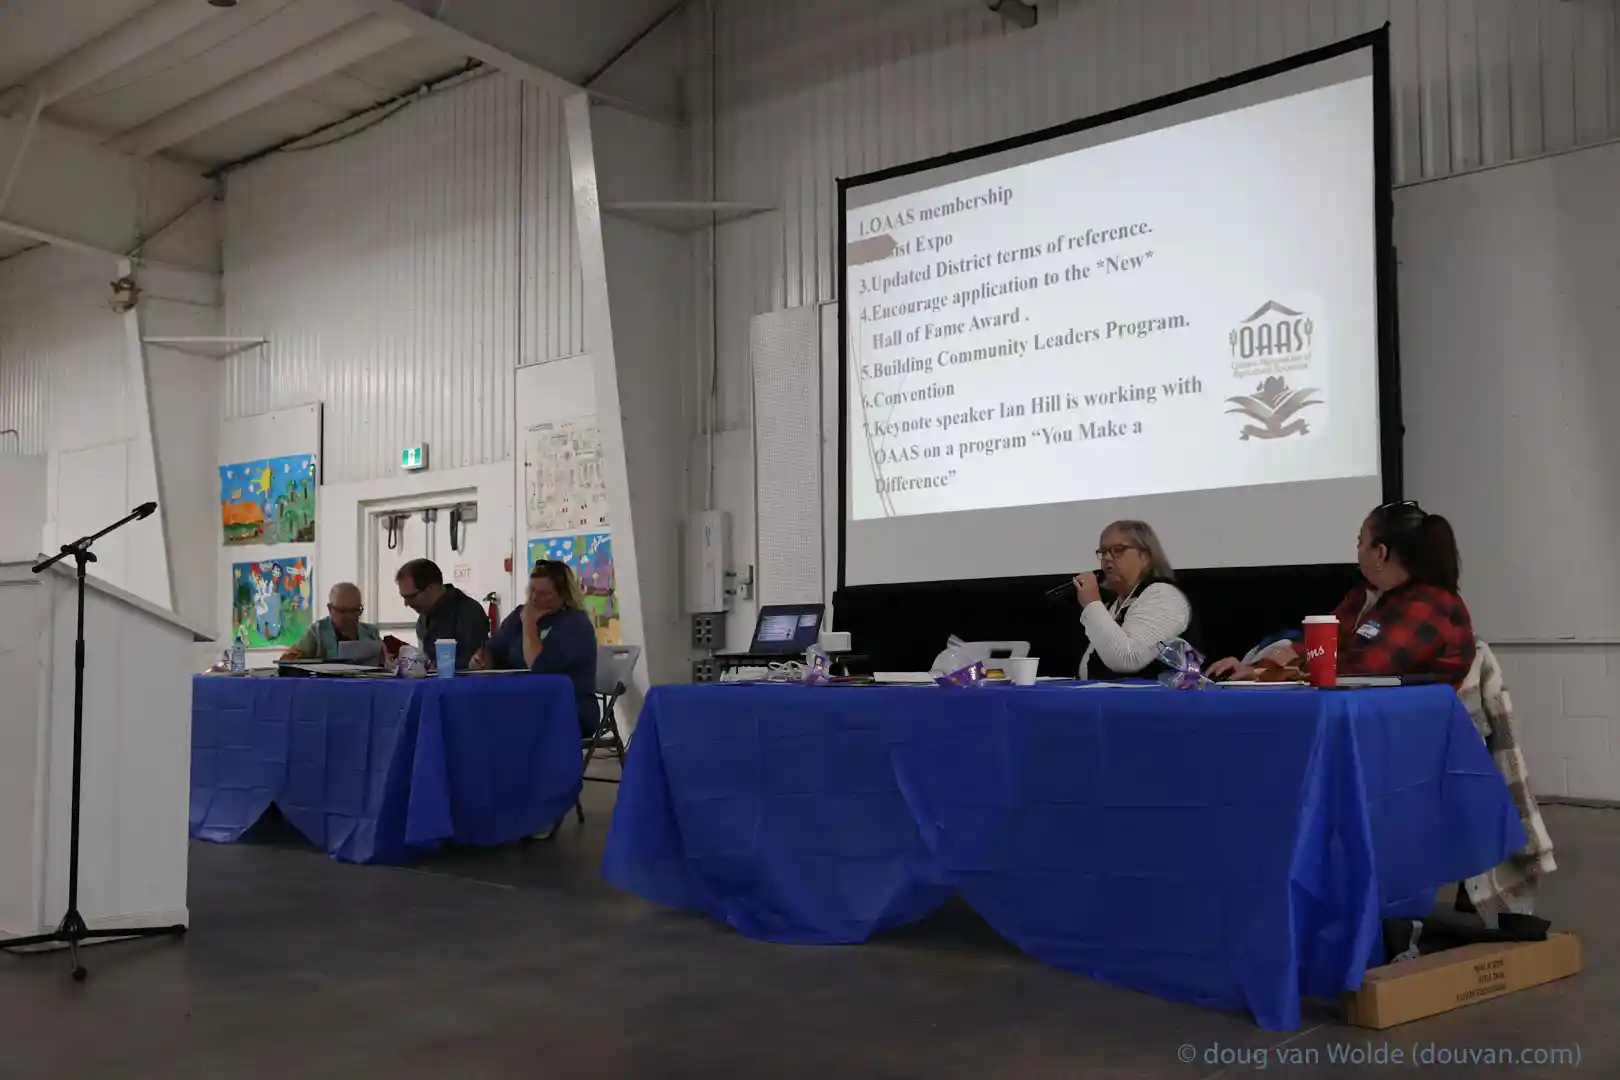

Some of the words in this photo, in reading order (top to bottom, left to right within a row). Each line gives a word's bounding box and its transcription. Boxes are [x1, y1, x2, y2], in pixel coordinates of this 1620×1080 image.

[860, 208, 916, 236] 1.OAAS
[919, 186, 1013, 221] membership
[860, 264, 931, 294] 3.Updated
[937, 252, 992, 278] District
[997, 244, 1042, 265] terms
[1047, 235, 1065, 253] of
[1068, 221, 1153, 249] reference.
[916, 233, 953, 253] Expo
[860, 295, 948, 323] 4.Encourage
[952, 275, 1038, 308] application
[1044, 272, 1059, 286] to
[1065, 264, 1090, 282] the
[861, 356, 933, 381] 5.Building
[937, 338, 1028, 367] Community
[1034, 328, 1100, 351] Leaders
[1106, 313, 1191, 339] Program.
[873, 330, 902, 350] Hall
[906, 326, 921, 343] of
[925, 322, 965, 341] Fame
[969, 306, 1020, 332] Award
[1239, 318, 1304, 359] OAAS
[862, 382, 955, 410] 6.Convention
[863, 415, 933, 439] 7.Keynote
[936, 406, 995, 431] speaker
[999, 402, 1025, 419] Ian
[1031, 394, 1061, 415] Hill
[1066, 393, 1079, 410] is
[1084, 384, 1158, 407] working
[1162, 375, 1202, 397] with
[874, 444, 919, 465] OAAS
[924, 444, 941, 459] on
[946, 443, 954, 456] a
[959, 434, 1026, 459] program
[1031, 426, 1073, 446] “You
[1079, 420, 1128, 441] Make
[1132, 420, 1142, 434] a
[875, 469, 957, 494] Difference”
[453, 567, 472, 579] EXIT
